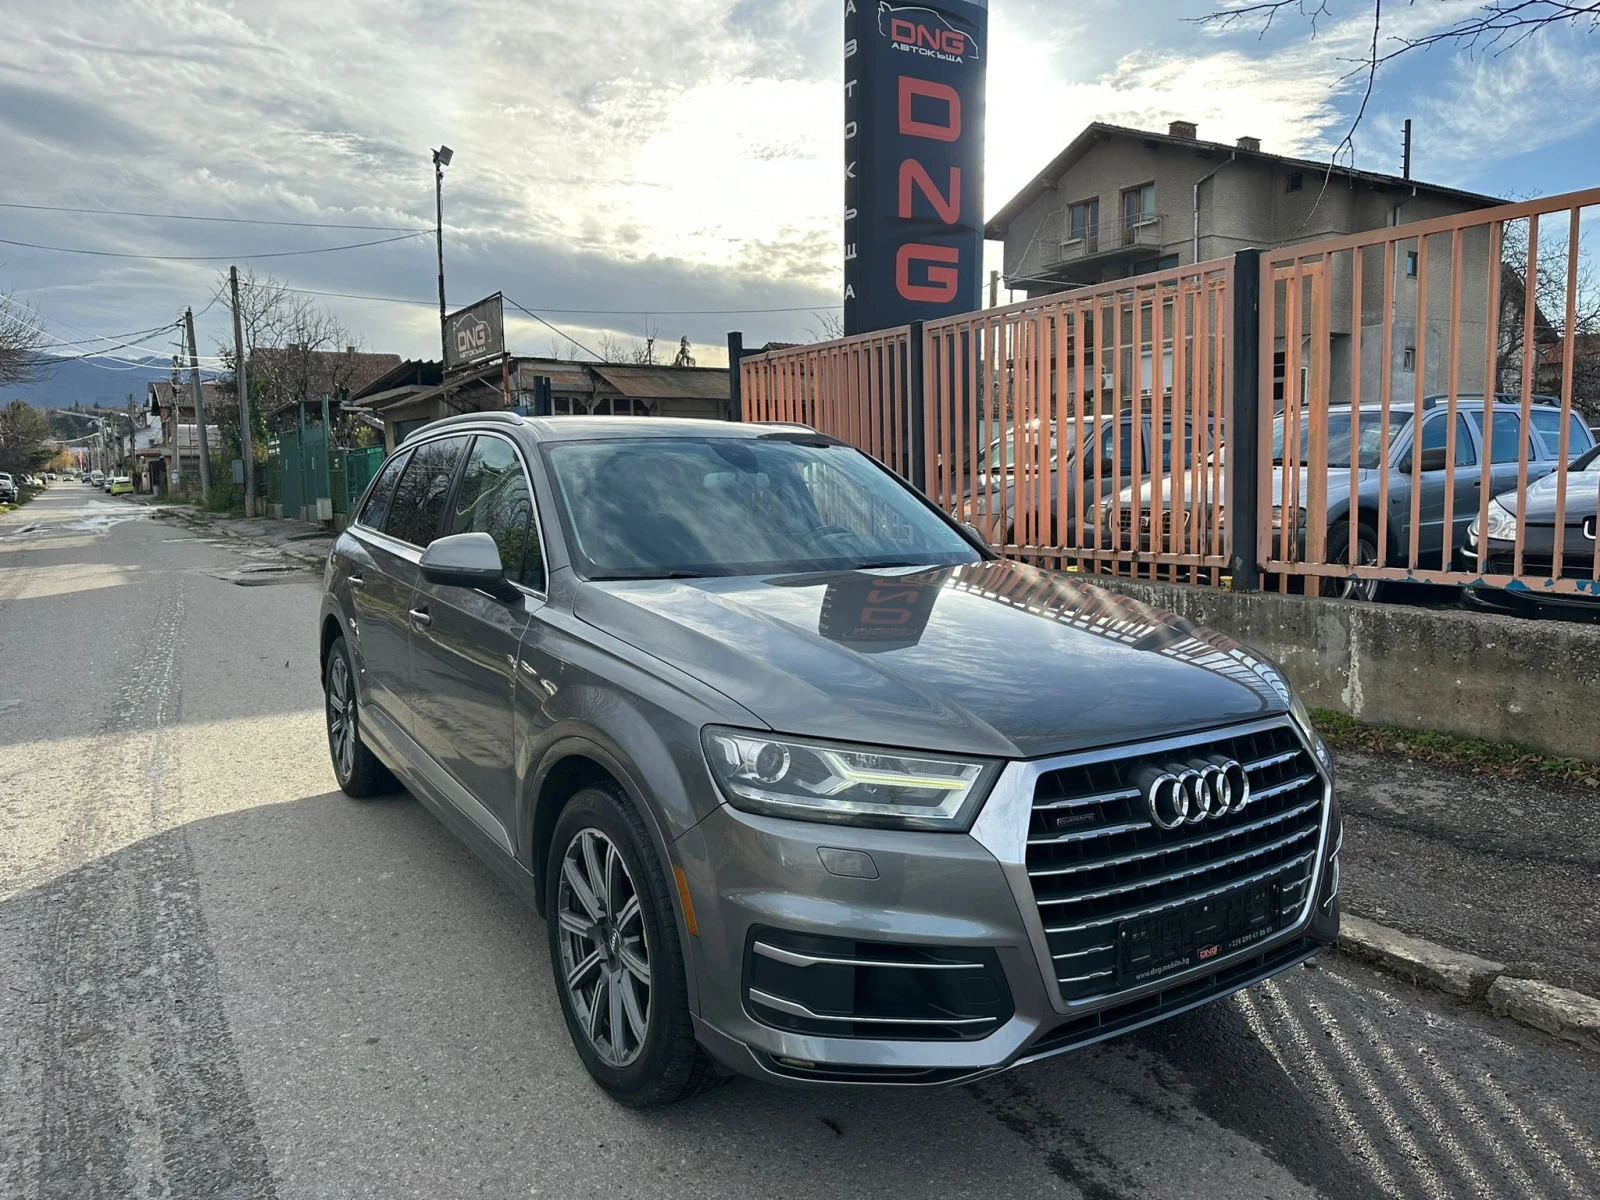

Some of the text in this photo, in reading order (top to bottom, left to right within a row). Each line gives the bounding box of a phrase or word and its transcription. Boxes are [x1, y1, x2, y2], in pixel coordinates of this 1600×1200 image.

[891, 18, 965, 56] DNG
[896, 75, 961, 303] DNG
[457, 324, 485, 352] DNG
[1199, 945, 1218, 958] DNG
